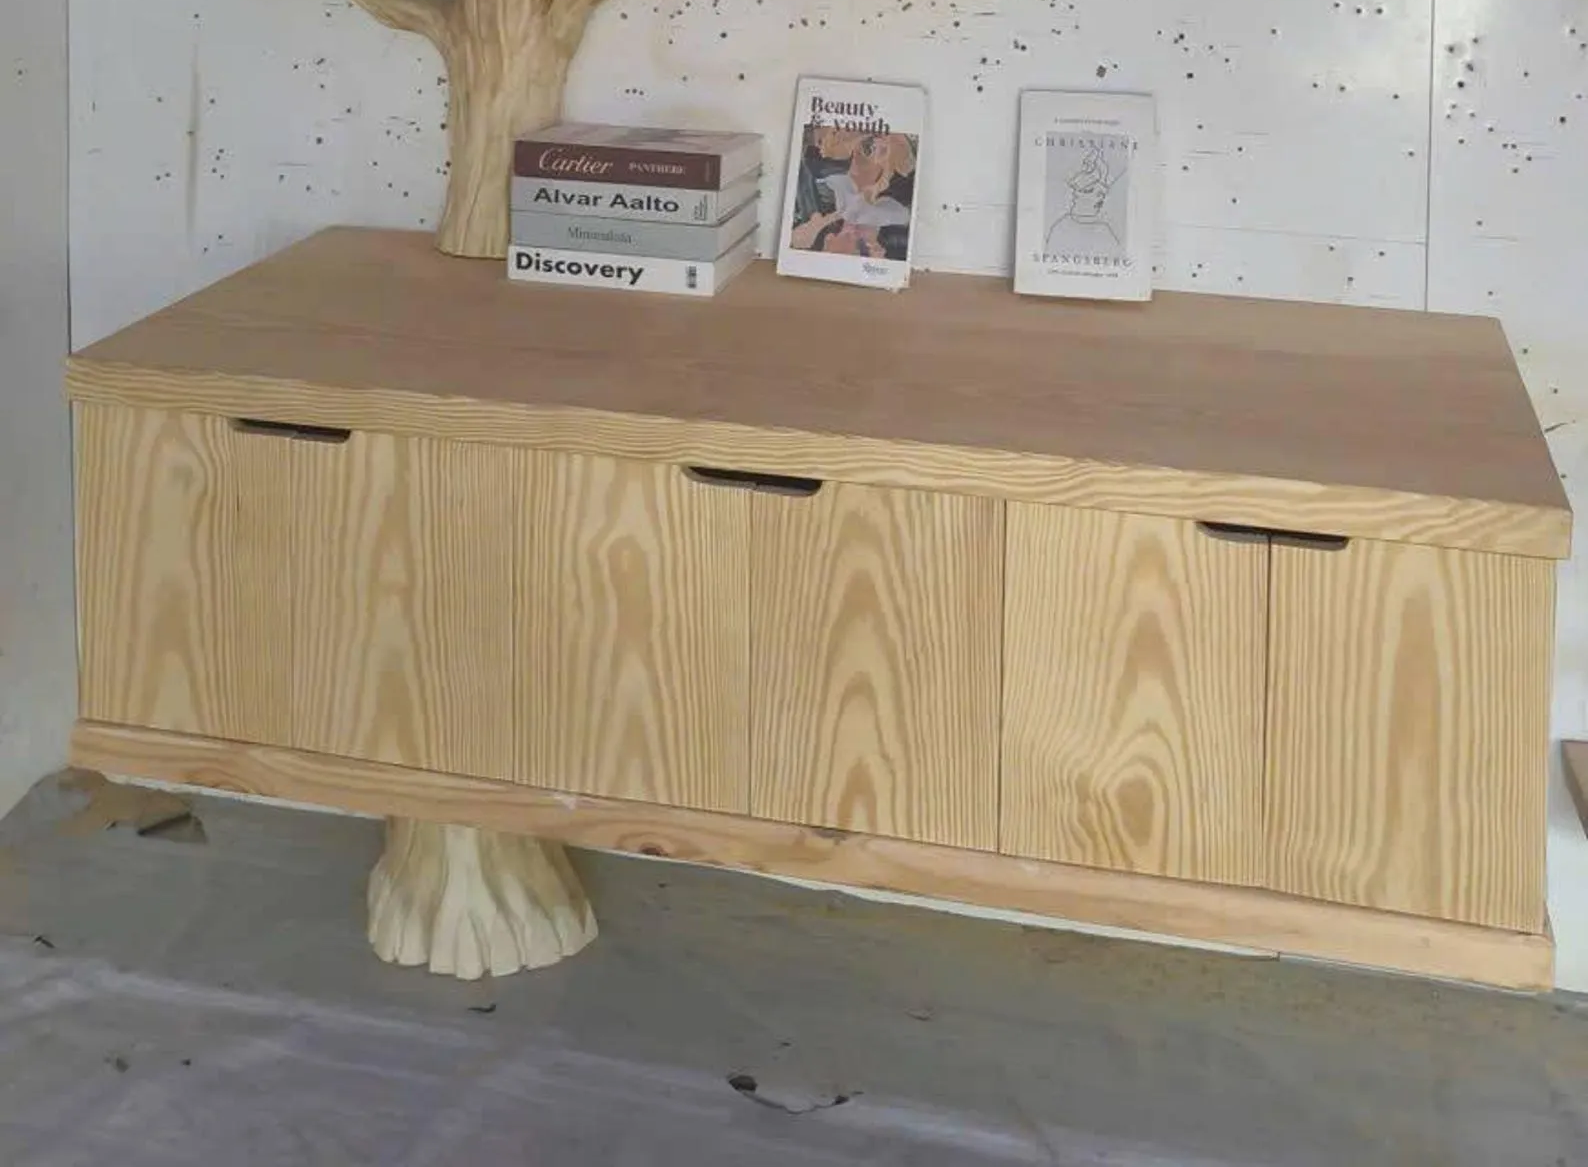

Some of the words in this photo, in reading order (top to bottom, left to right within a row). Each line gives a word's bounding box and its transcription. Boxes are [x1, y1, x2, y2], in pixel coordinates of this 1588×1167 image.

[811, 96, 879, 117] Beauty
[832, 117, 890, 136] youth
[539, 145, 614, 176] Cartier
[533, 187, 604, 208] Alvar
[608, 192, 680, 214] Aalto
[515, 252, 645, 286] Discovery
